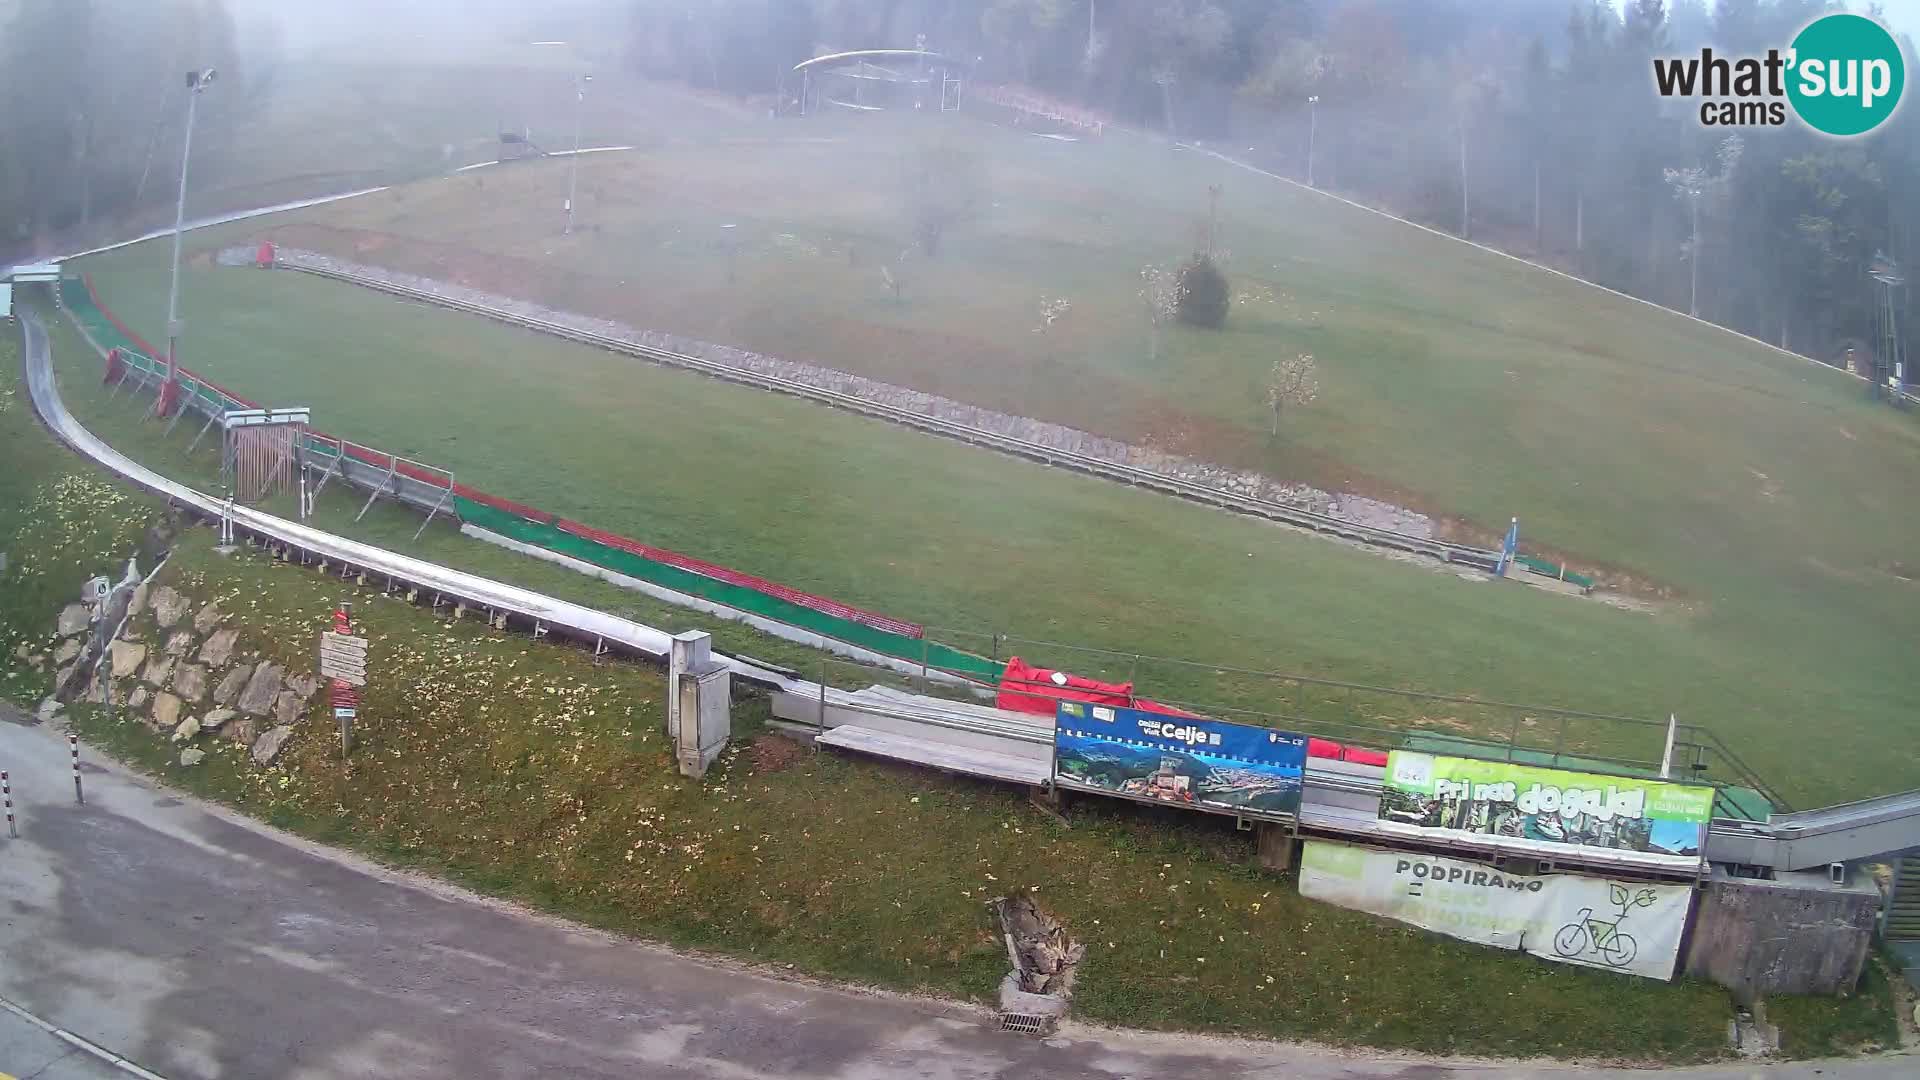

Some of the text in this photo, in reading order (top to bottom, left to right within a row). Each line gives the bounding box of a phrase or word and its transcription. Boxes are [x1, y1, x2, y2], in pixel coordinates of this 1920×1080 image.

[1161, 723, 1207, 745] Celje
[1433, 777, 1470, 801] Pri
[1474, 781, 1517, 802] nas
[1395, 859, 1545, 893] PODPIRAMO
